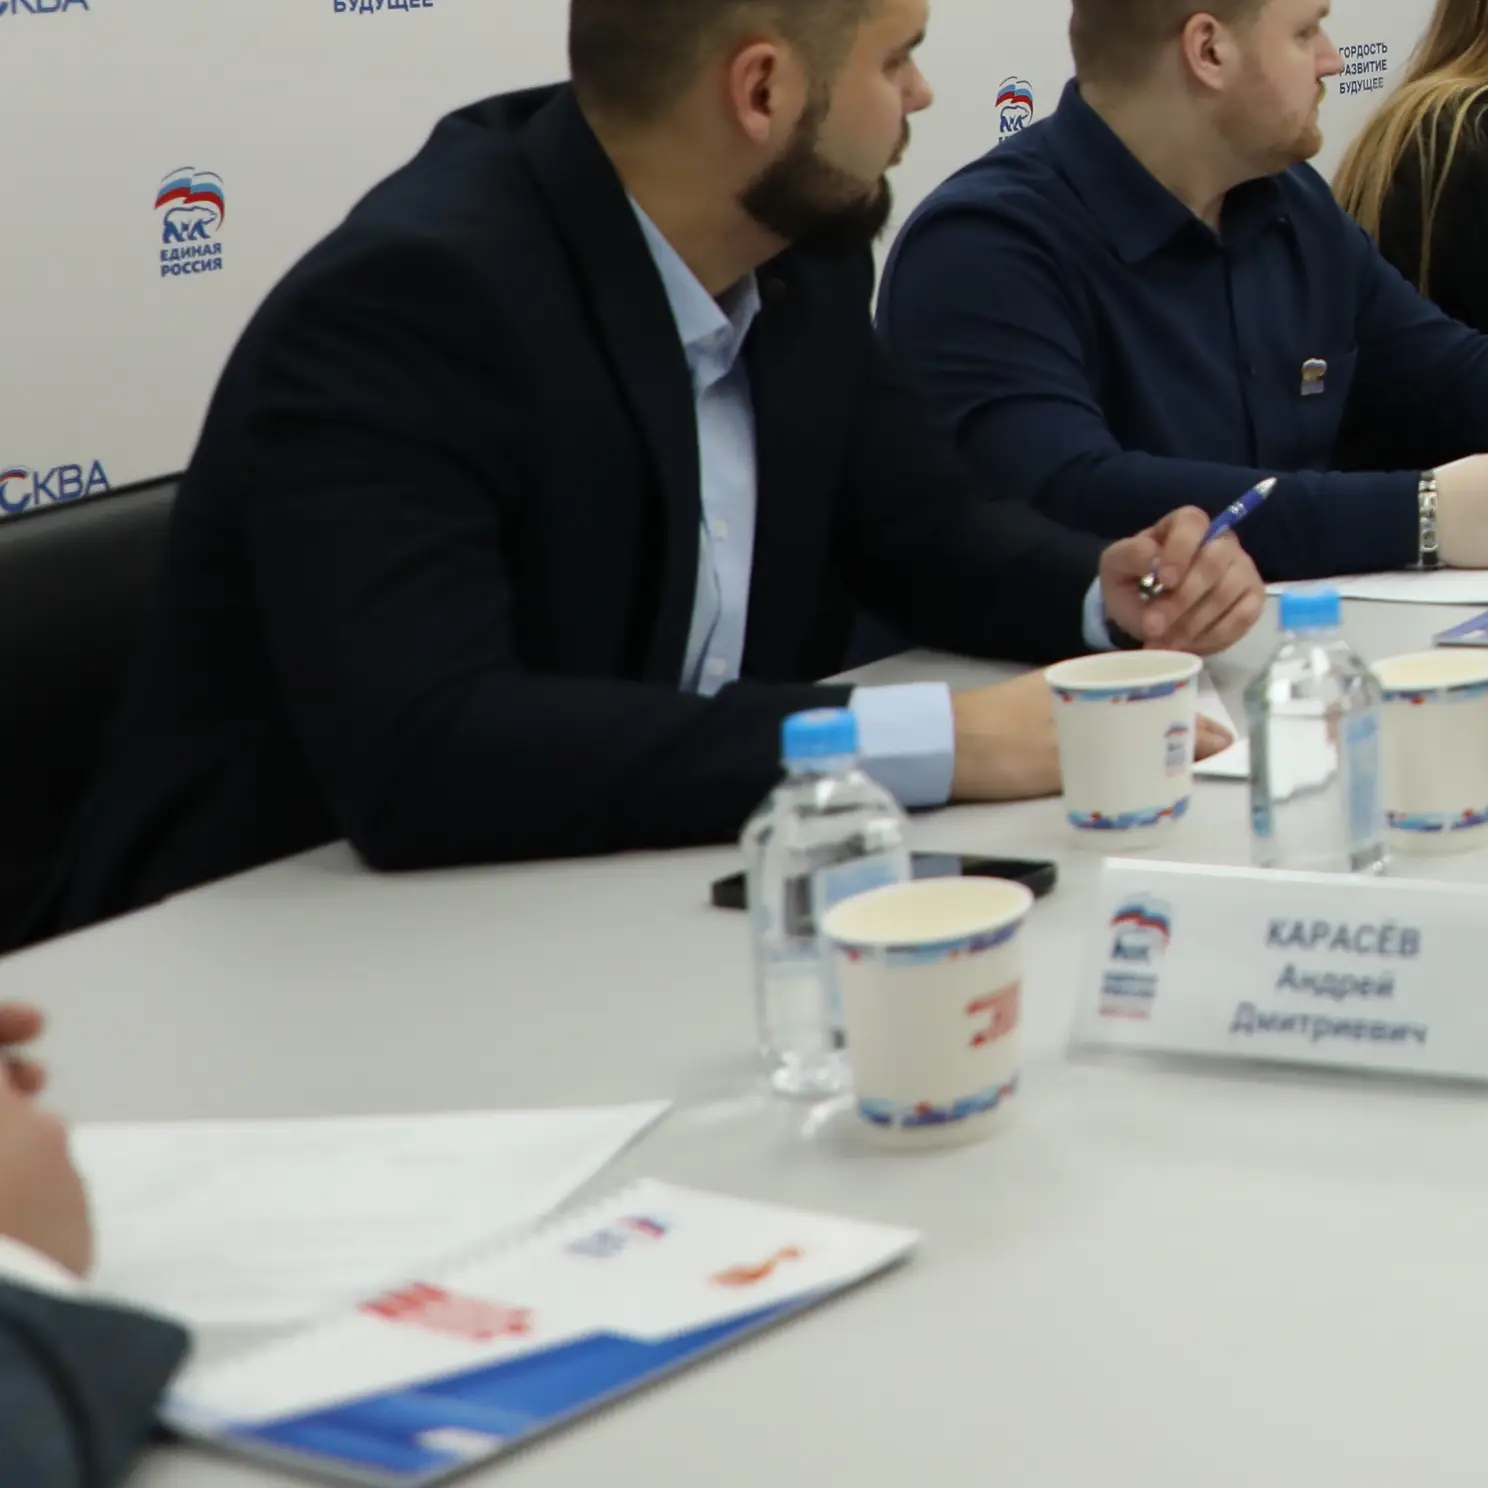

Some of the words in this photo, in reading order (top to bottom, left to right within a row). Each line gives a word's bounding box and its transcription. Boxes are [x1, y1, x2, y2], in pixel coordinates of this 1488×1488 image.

[160, 242, 222, 263] ЕДИНАЯ
[160, 257, 224, 277] РОССИЯ
[1265, 917, 1422, 958] КАРАСЁВ
[1276, 963, 1394, 1002] Андрей
[1229, 1001, 1429, 1045] Дмитриевич
